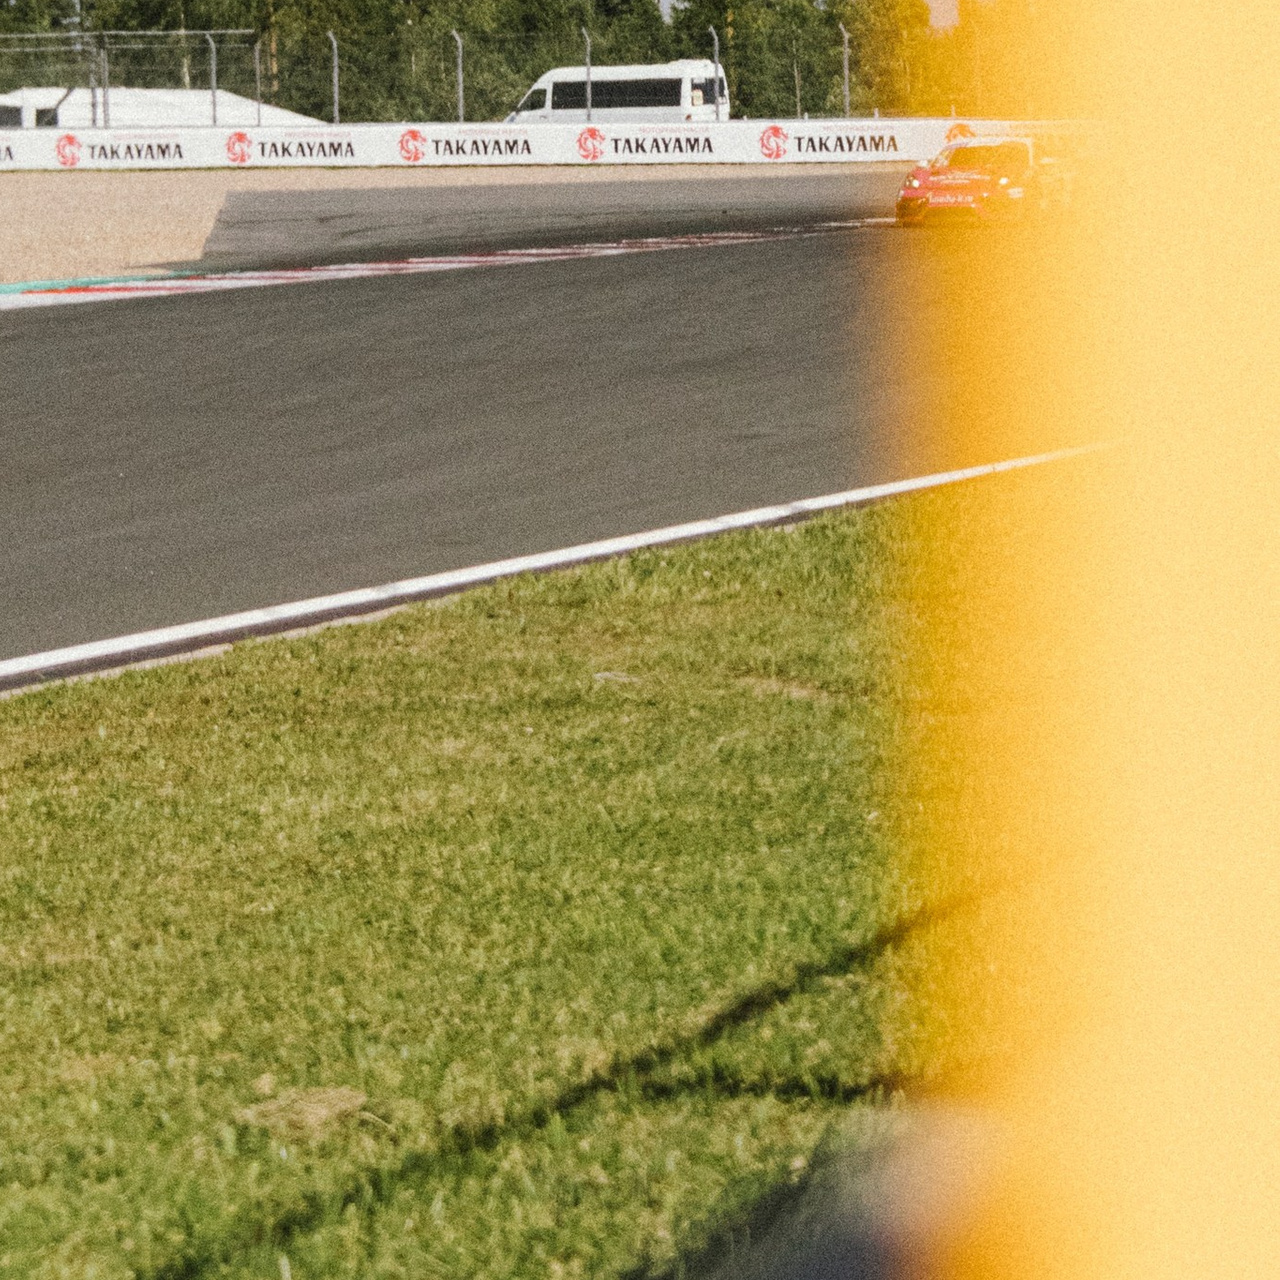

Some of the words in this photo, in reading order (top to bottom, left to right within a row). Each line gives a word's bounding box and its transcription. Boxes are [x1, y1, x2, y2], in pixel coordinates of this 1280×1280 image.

[89, 143, 184, 160] TAKAYAMA
[259, 141, 355, 158] TAKAYAMA
[432, 139, 532, 155] TAKAYAMA
[611, 137, 714, 153] TAKAYAMA
[795, 135, 899, 152] TAKAYAMA
